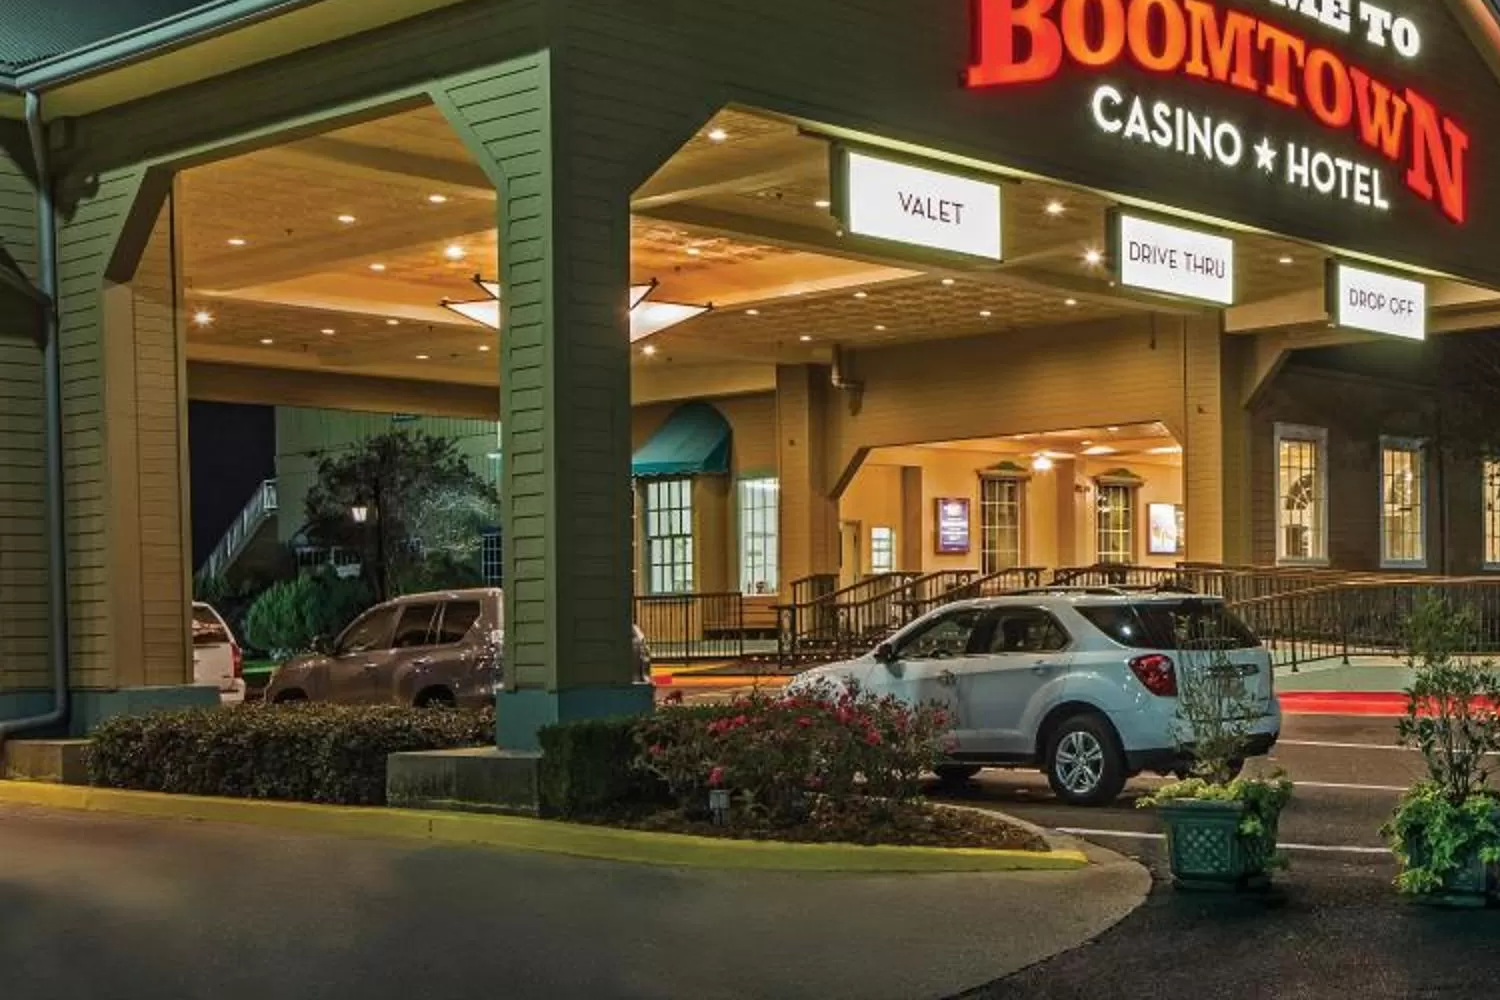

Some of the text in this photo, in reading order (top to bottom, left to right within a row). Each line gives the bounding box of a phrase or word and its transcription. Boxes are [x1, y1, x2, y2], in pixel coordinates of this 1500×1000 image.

[1359, 1, 1420, 57] TO
[1092, 84, 1389, 209] CASINO HOTEL
[898, 191, 964, 225] VALET
[1129, 241, 1225, 279] DRIVE THRU
[1349, 287, 1415, 316] DROP OFF
